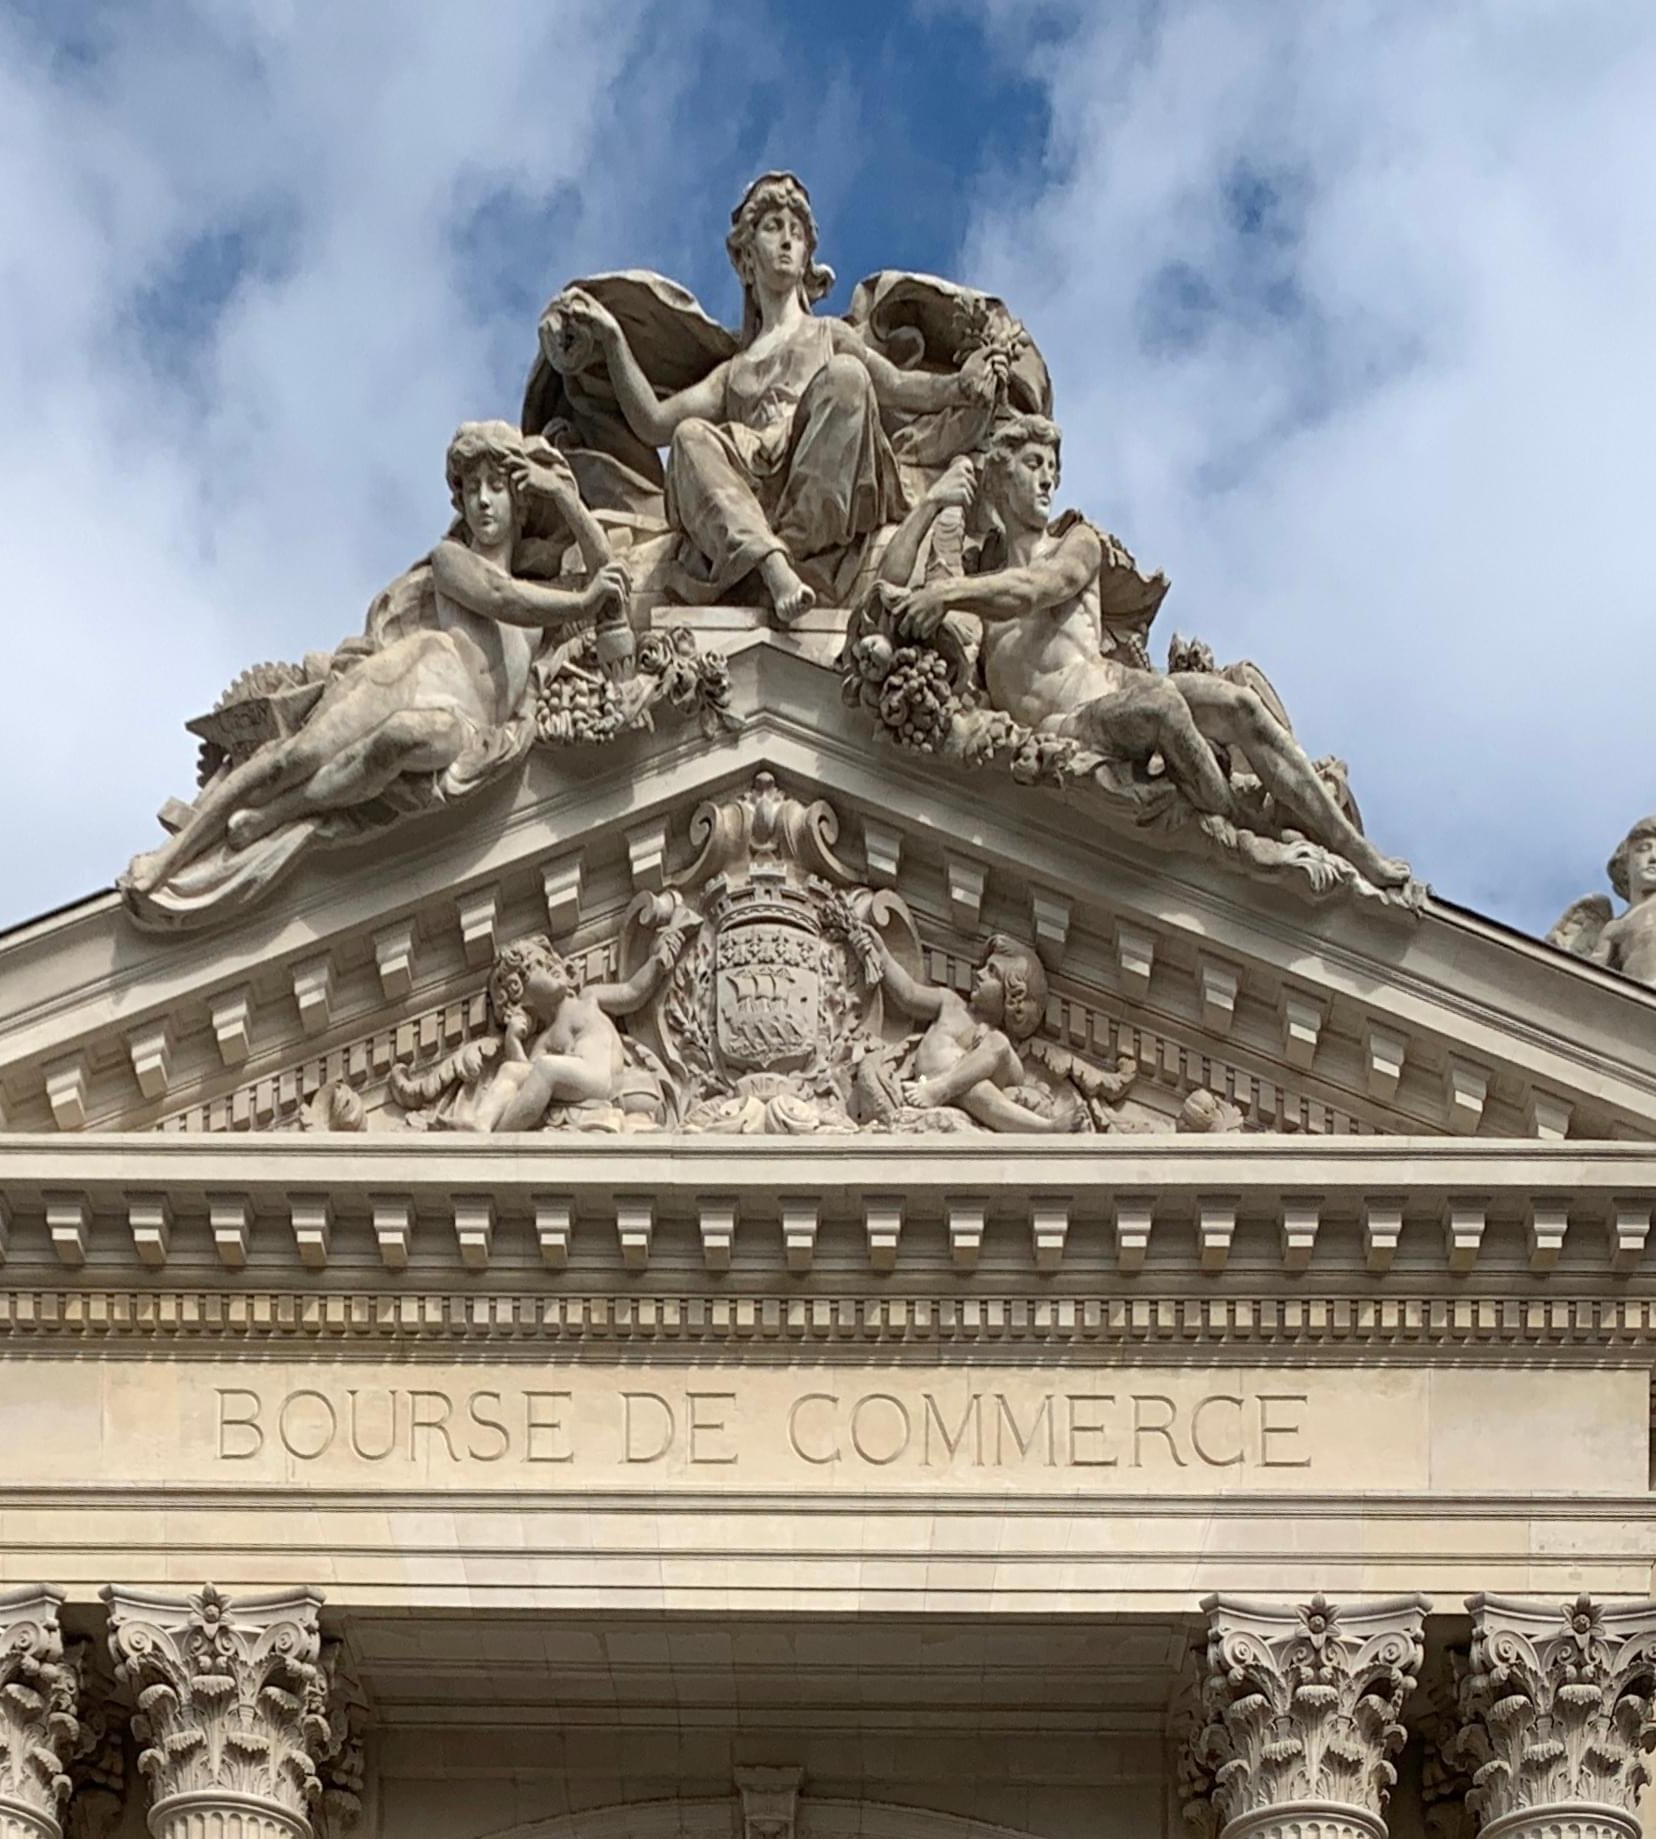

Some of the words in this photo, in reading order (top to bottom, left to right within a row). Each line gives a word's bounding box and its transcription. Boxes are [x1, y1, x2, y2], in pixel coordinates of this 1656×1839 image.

[213, 1388, 575, 1465] BOURSE
[618, 1391, 739, 1465] DE
[786, 1392, 1312, 1469] COMMERCE
